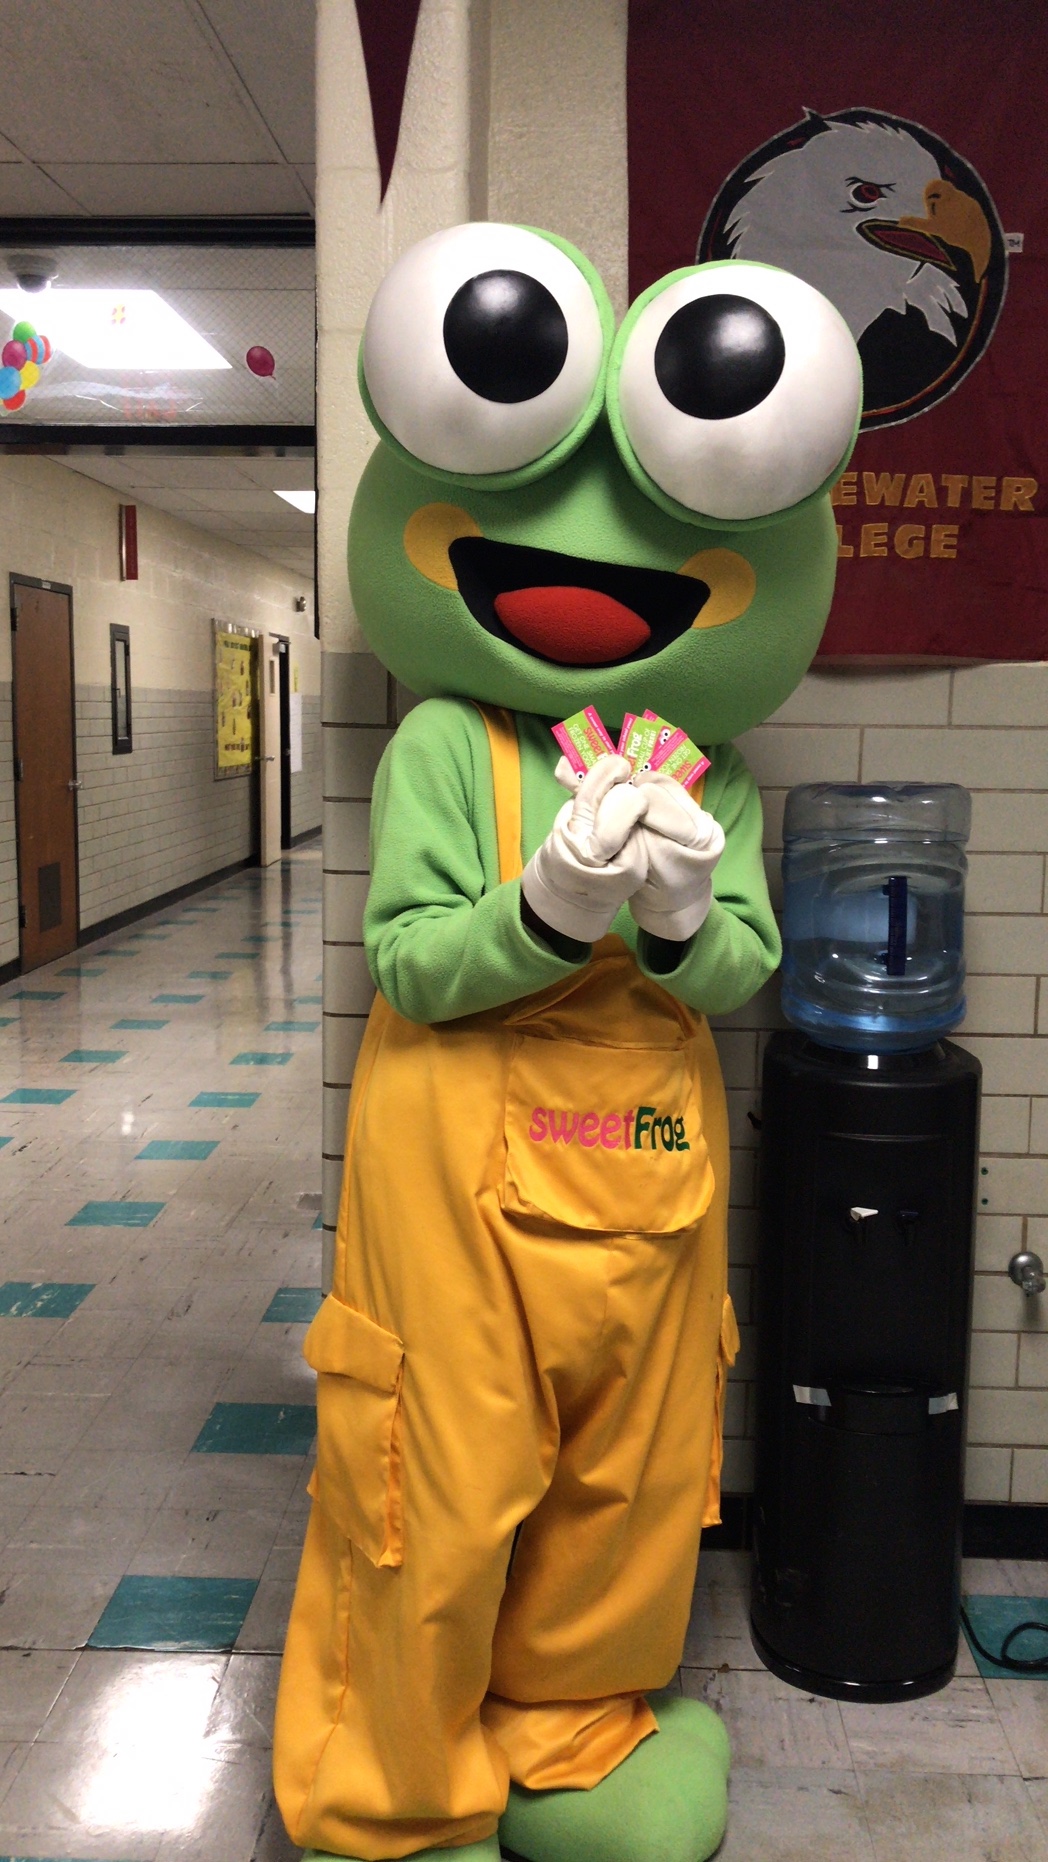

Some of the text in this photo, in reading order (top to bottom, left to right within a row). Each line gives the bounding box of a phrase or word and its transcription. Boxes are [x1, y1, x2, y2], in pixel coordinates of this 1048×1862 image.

[829, 472, 1038, 511] EWATER
[836, 523, 959, 559] LEGE
[567, 726, 584, 751] FROZEN
[572, 723, 582, 736] GET
[578, 735, 590, 750] ONE
[529, 1106, 690, 1152] sweetFrog
